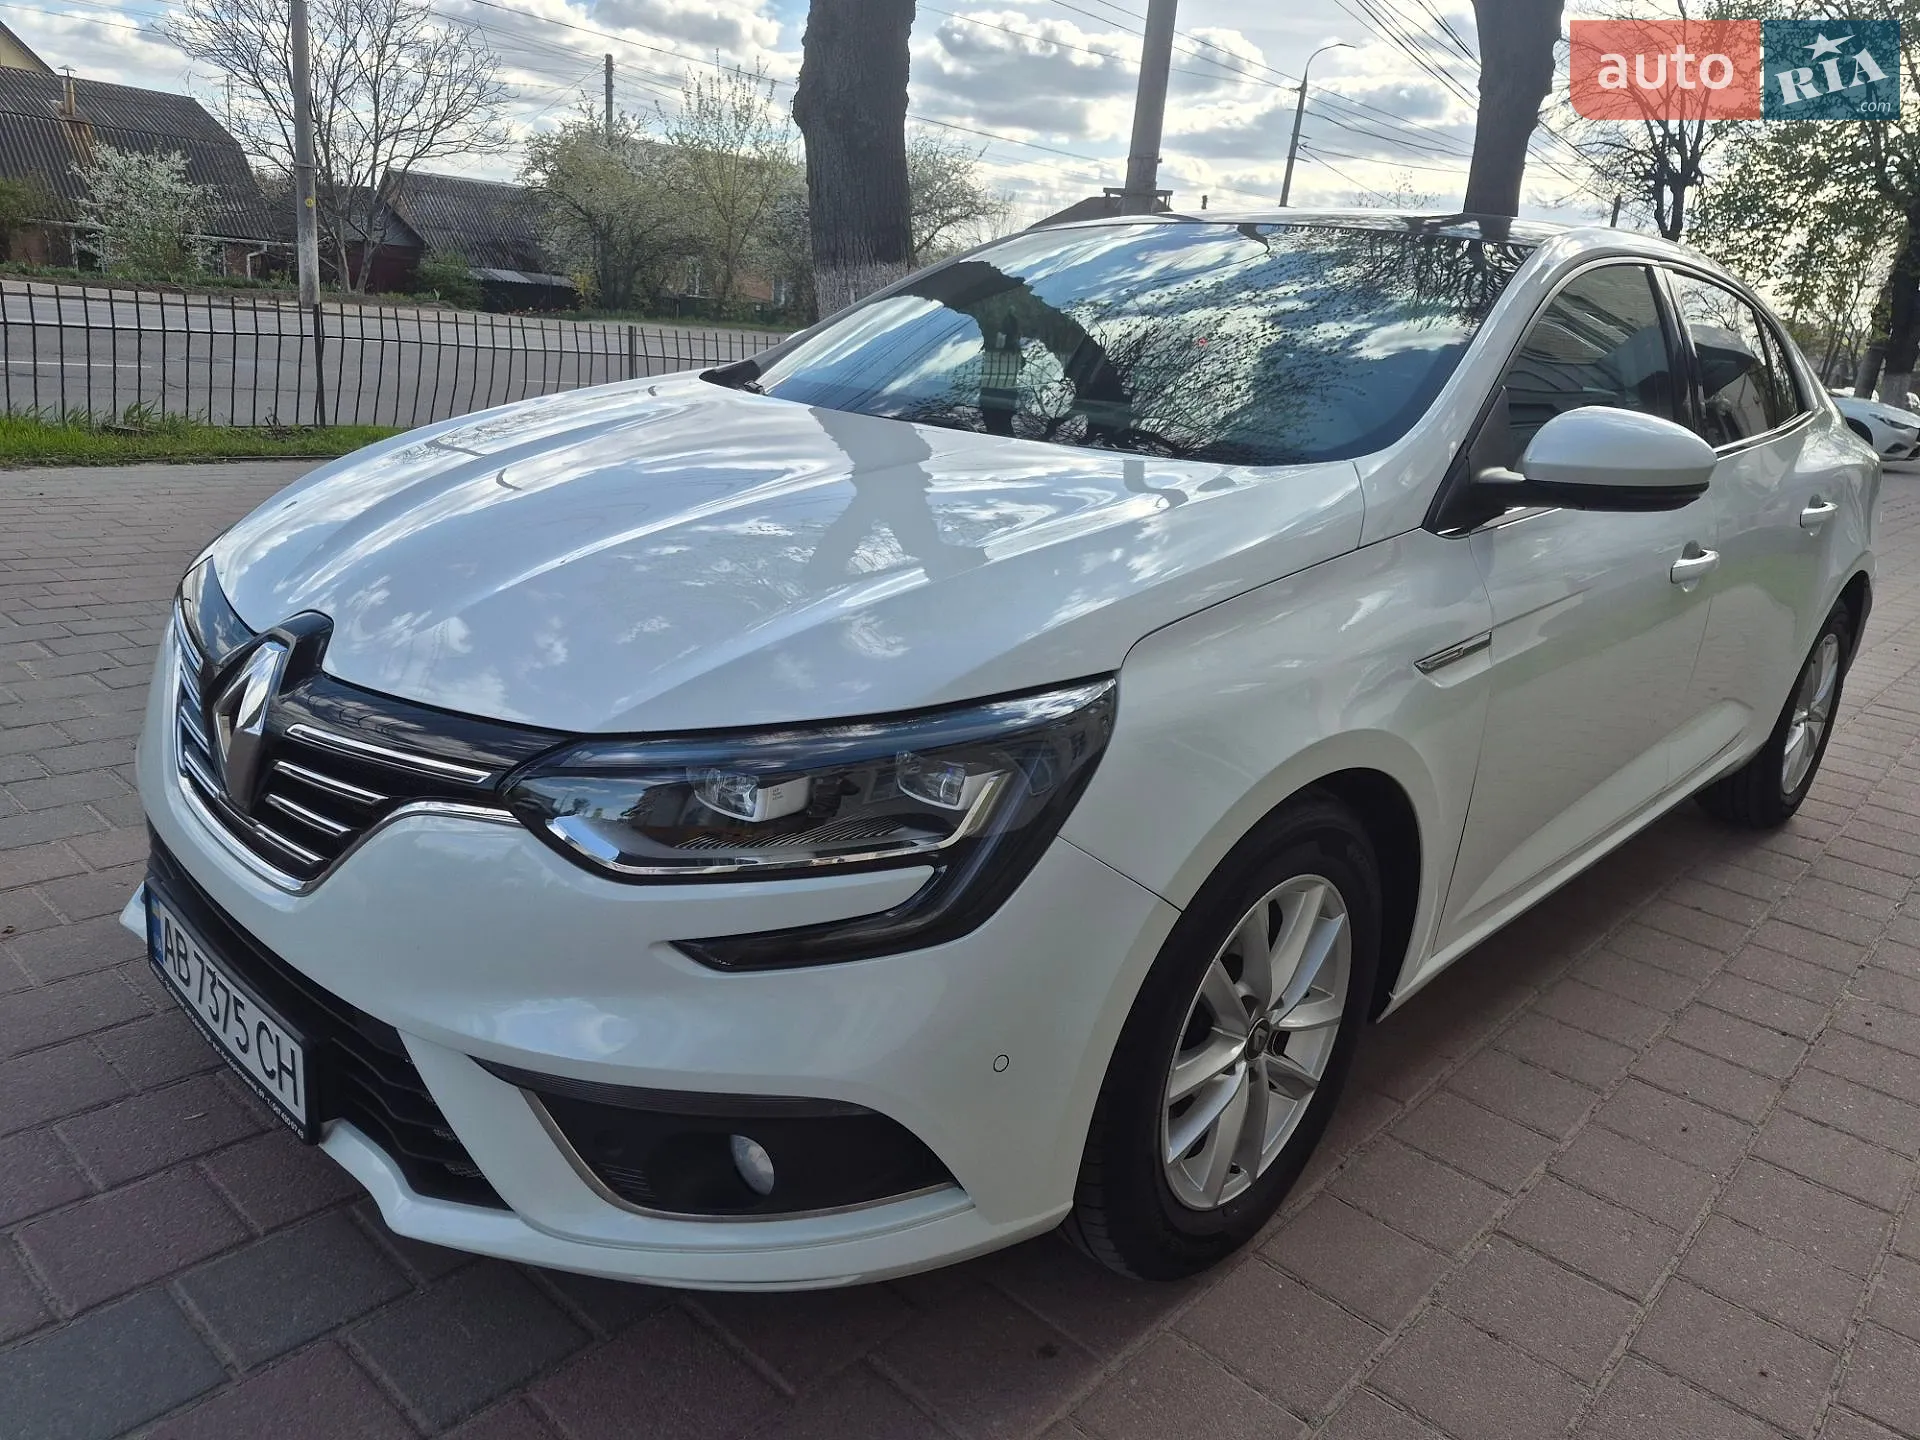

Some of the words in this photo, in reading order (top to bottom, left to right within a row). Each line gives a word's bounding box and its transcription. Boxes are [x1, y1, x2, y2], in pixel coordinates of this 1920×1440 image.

[164, 918, 191, 988] AB
[193, 950, 250, 1055] 7375
[256, 1020, 299, 1107] CH
